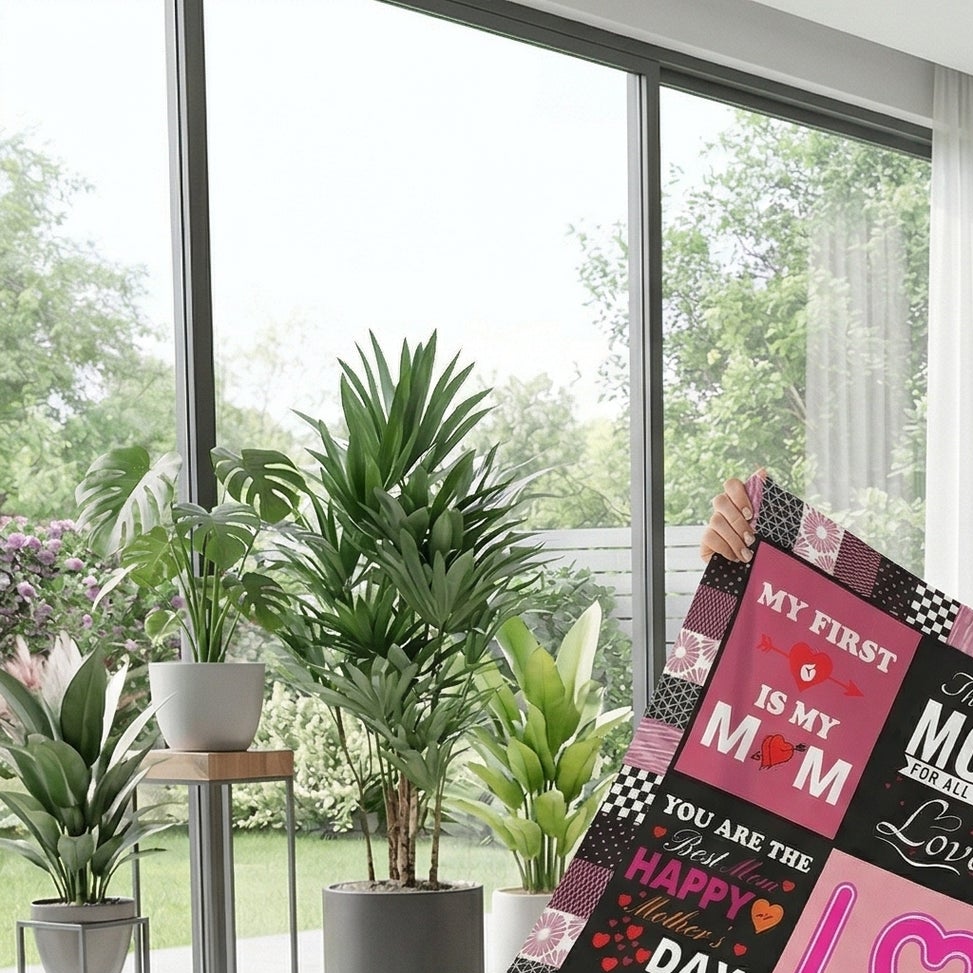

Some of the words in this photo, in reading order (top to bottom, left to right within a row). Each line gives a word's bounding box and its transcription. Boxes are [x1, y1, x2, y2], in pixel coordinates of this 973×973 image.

[757, 582, 808, 622] MY
[809, 609, 897, 673] FIRST
[754, 684, 787, 715] IS
[789, 701, 840, 739] MY
[910, 763, 938, 784] FOR
[943, 779, 968, 799] ALL
[663, 794, 715, 828] YOU
[714, 819, 765, 851] ARE
[768, 840, 813, 874] THE
[663, 829, 729, 867] Best
[624, 846, 756, 920] HAPPY
